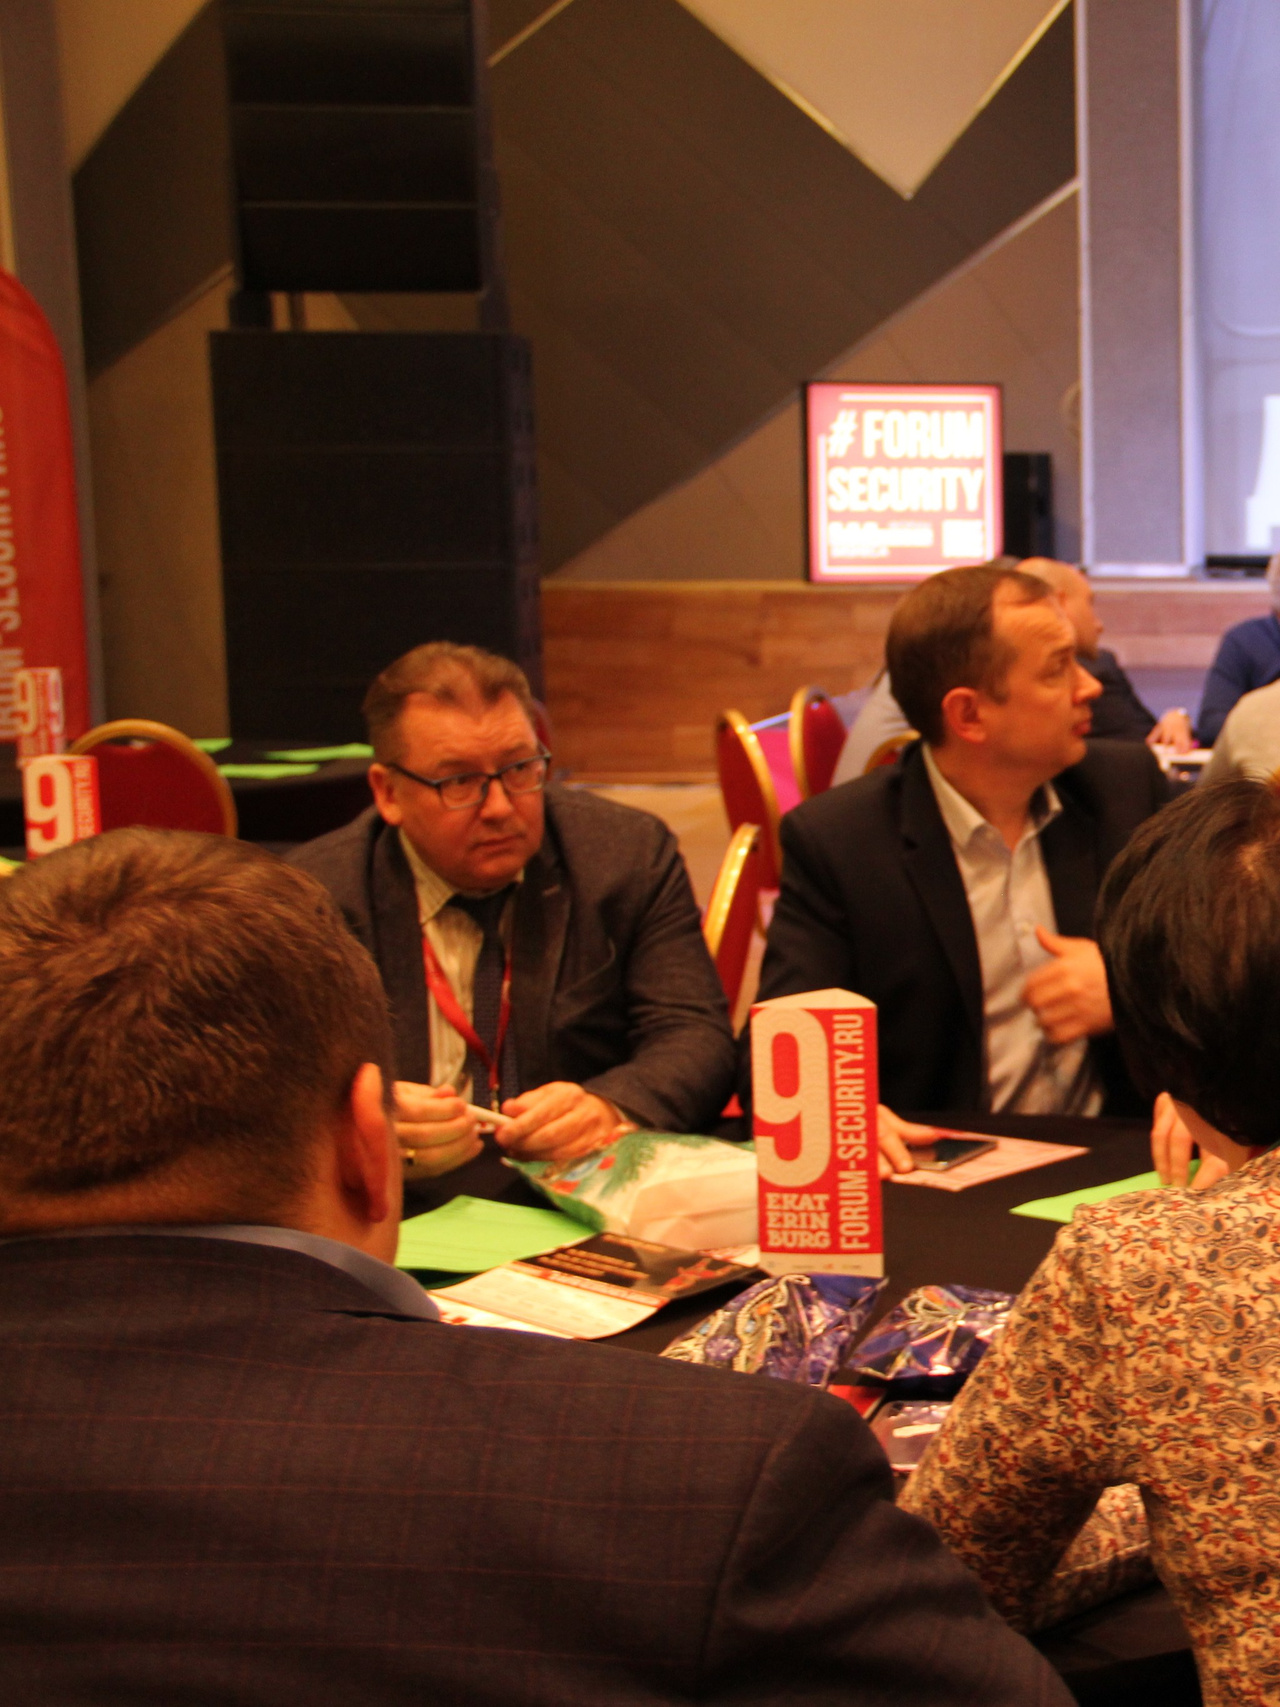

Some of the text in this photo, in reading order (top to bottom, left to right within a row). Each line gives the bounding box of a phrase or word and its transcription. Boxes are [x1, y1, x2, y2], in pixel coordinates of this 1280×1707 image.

[862, 410, 983, 458] FORUM
[827, 466, 983, 512] SECURITY
[25, 757, 76, 854] 9
[752, 1007, 831, 1188] 9
[833, 1013, 870, 1250] FORUM-SECURITY.RU
[765, 1192, 830, 1211] EKAT
[766, 1211, 830, 1230] ERIN
[767, 1229, 831, 1249] BURG
